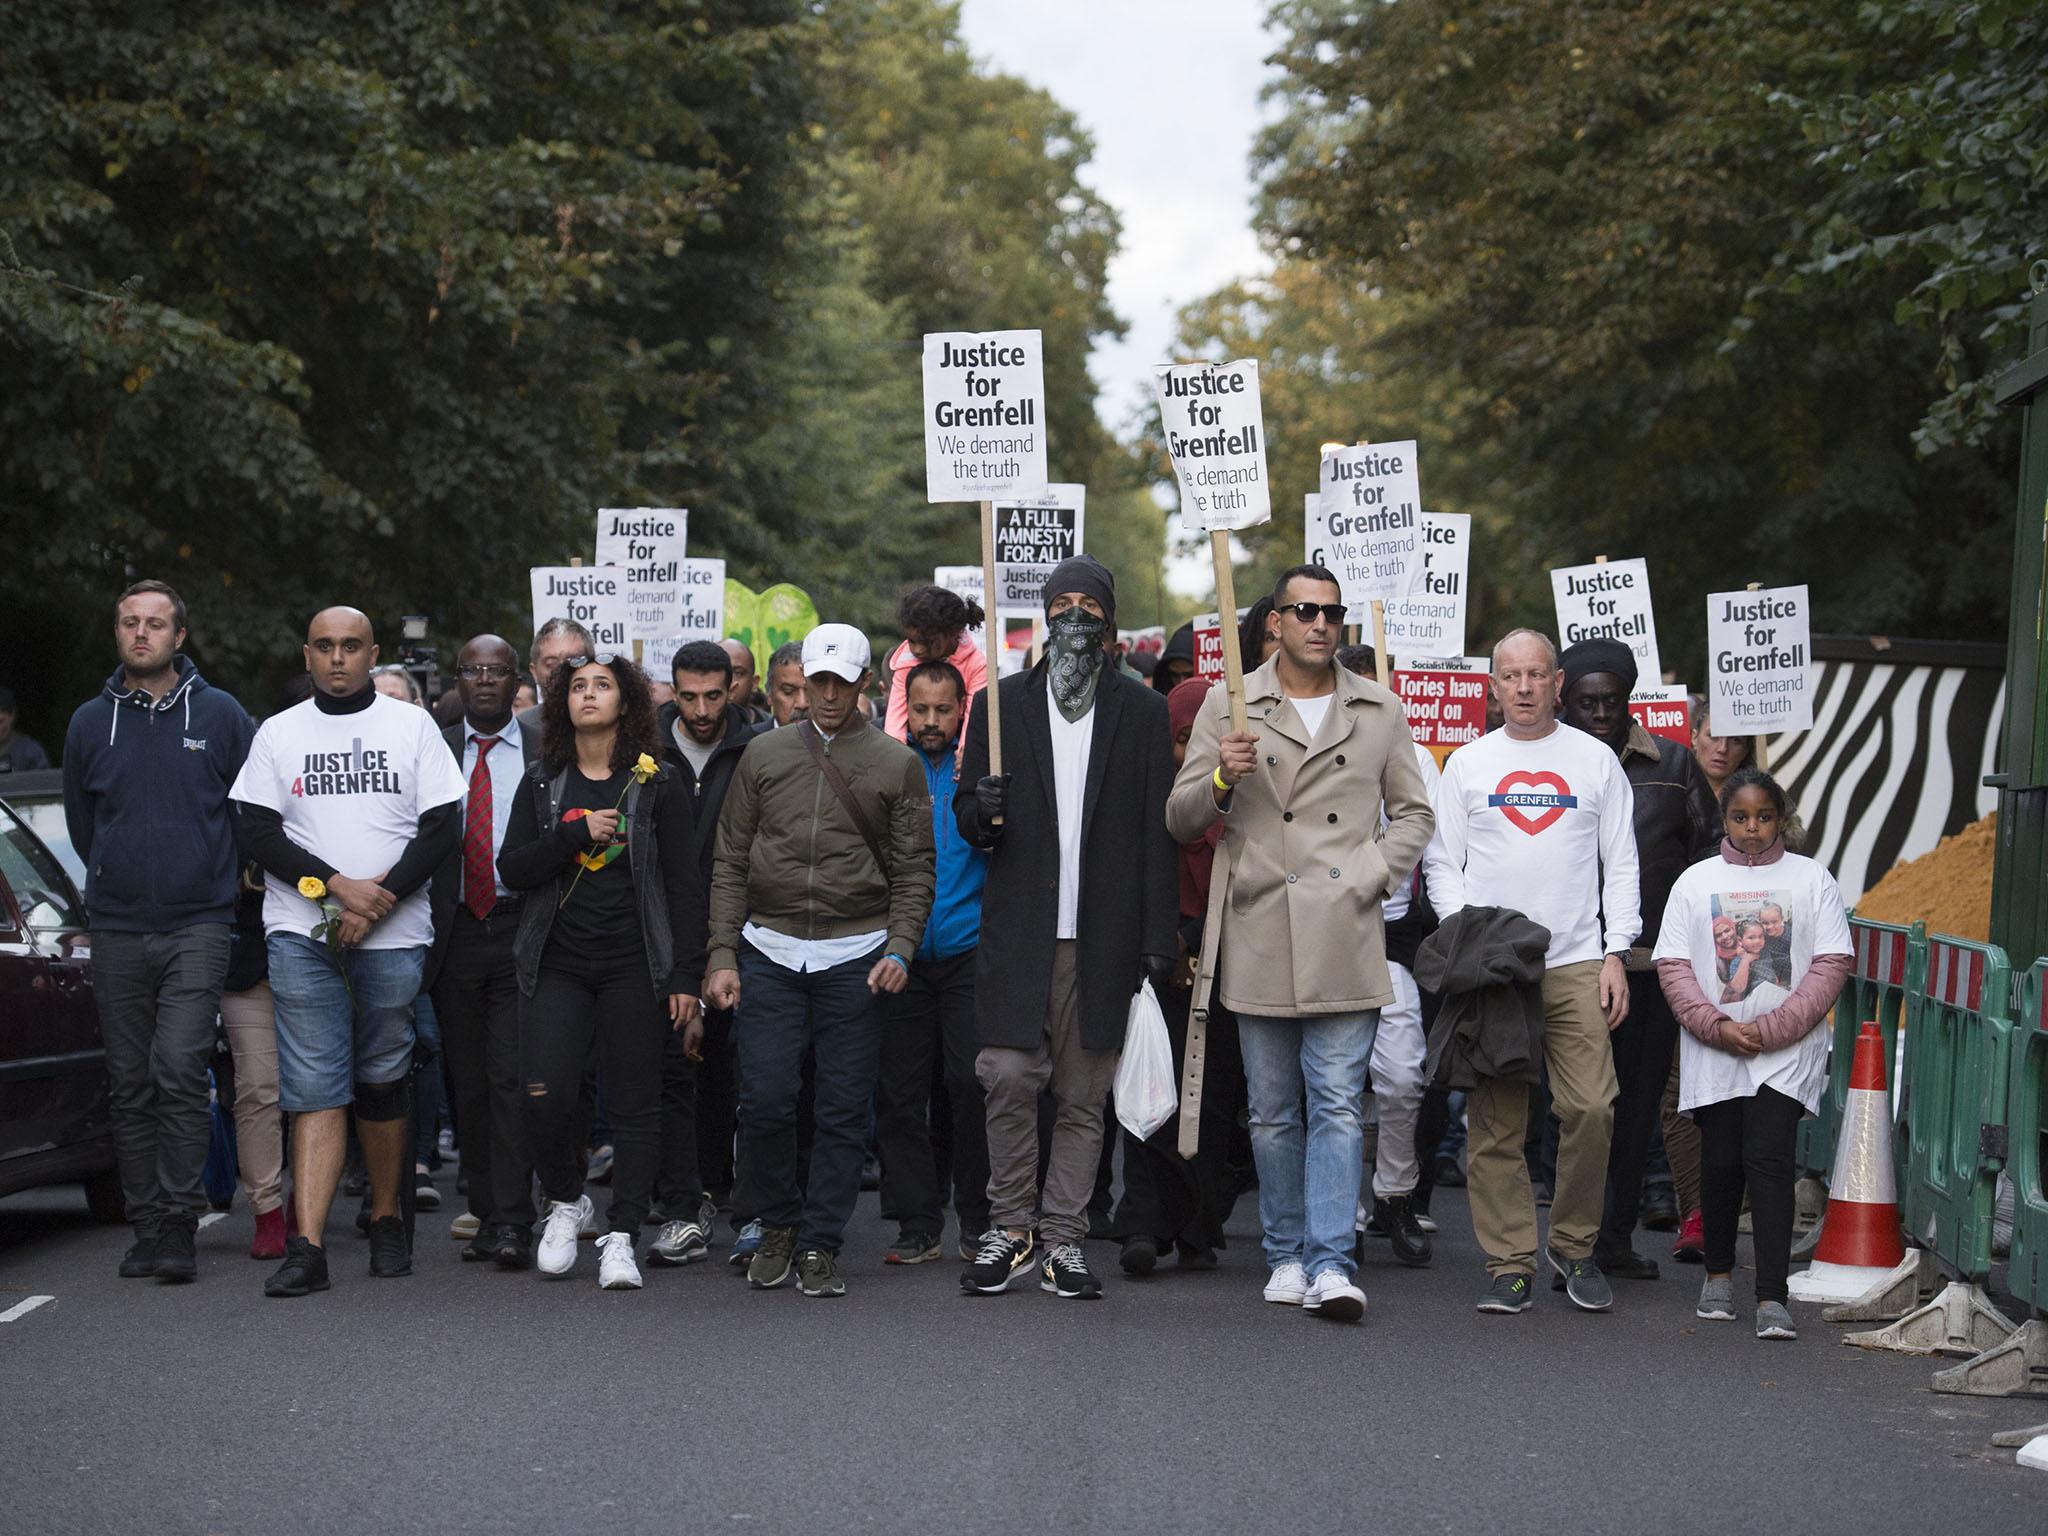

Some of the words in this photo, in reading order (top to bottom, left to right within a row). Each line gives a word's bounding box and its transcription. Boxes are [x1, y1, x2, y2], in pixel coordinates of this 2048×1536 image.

[940, 341, 1025, 368] Justice
[965, 371, 1001, 397] for
[1164, 368, 1244, 397] Justice
[935, 399, 1034, 427] Grenfell
[1187, 399, 1222, 427] for
[938, 435, 966, 455] We
[970, 433, 1033, 454] demand
[1170, 425, 1258, 458] Grenfell
[953, 458, 978, 479] the
[982, 457, 1020, 478] truth
[1197, 461, 1259, 486] demand
[1331, 452, 1403, 482] Justice
[1212, 488, 1247, 510] truth
[1352, 482, 1385, 506] for
[610, 517, 675, 537] Justice
[1009, 510, 1021, 526] A
[1025, 510, 1063, 528] FULL
[1328, 502, 1414, 537] Grenfell
[997, 527, 1074, 546] AMNESTY
[1331, 542, 1357, 561] We
[1361, 533, 1415, 557] demand
[628, 540, 656, 559] for
[1003, 545, 1033, 562] FOR
[1002, 568, 1050, 583] Justice
[1346, 562, 1370, 581] the
[1374, 556, 1405, 579] truth
[546, 574, 616, 596] Justice
[1006, 585, 1044, 600] Gren
[1425, 571, 1459, 595] fell
[1566, 570, 1634, 596] Justice
[627, 588, 676, 604] demand
[1587, 597, 1617, 617] for
[567, 599, 597, 621] for
[636, 607, 664, 623] truth
[1399, 599, 1456, 619] demand
[1722, 597, 1797, 623] Justice
[592, 622, 624, 645] fell
[1384, 618, 1405, 636] the
[1409, 619, 1442, 639] truth
[1566, 613, 1647, 644] Grenfell
[1744, 624, 1777, 647] for
[1411, 660, 1445, 670] Socialist
[1445, 661, 1472, 671] Worker
[1717, 644, 1804, 674] Grenfell
[1398, 674, 1445, 697] Tories
[1449, 676, 1483, 699] have
[1640, 691, 1669, 700] Worker
[1719, 680, 1745, 698] We
[1748, 673, 1803, 696] demand
[1443, 703, 1462, 720] on
[1646, 706, 1684, 728] have
[1732, 699, 1755, 717] the
[1759, 696, 1792, 716] truth
[1409, 720, 1434, 742] eir
[1437, 720, 1480, 743] hands
[1504, 794, 1560, 806] GRENFELL
[1729, 890, 1769, 899] MISSING
